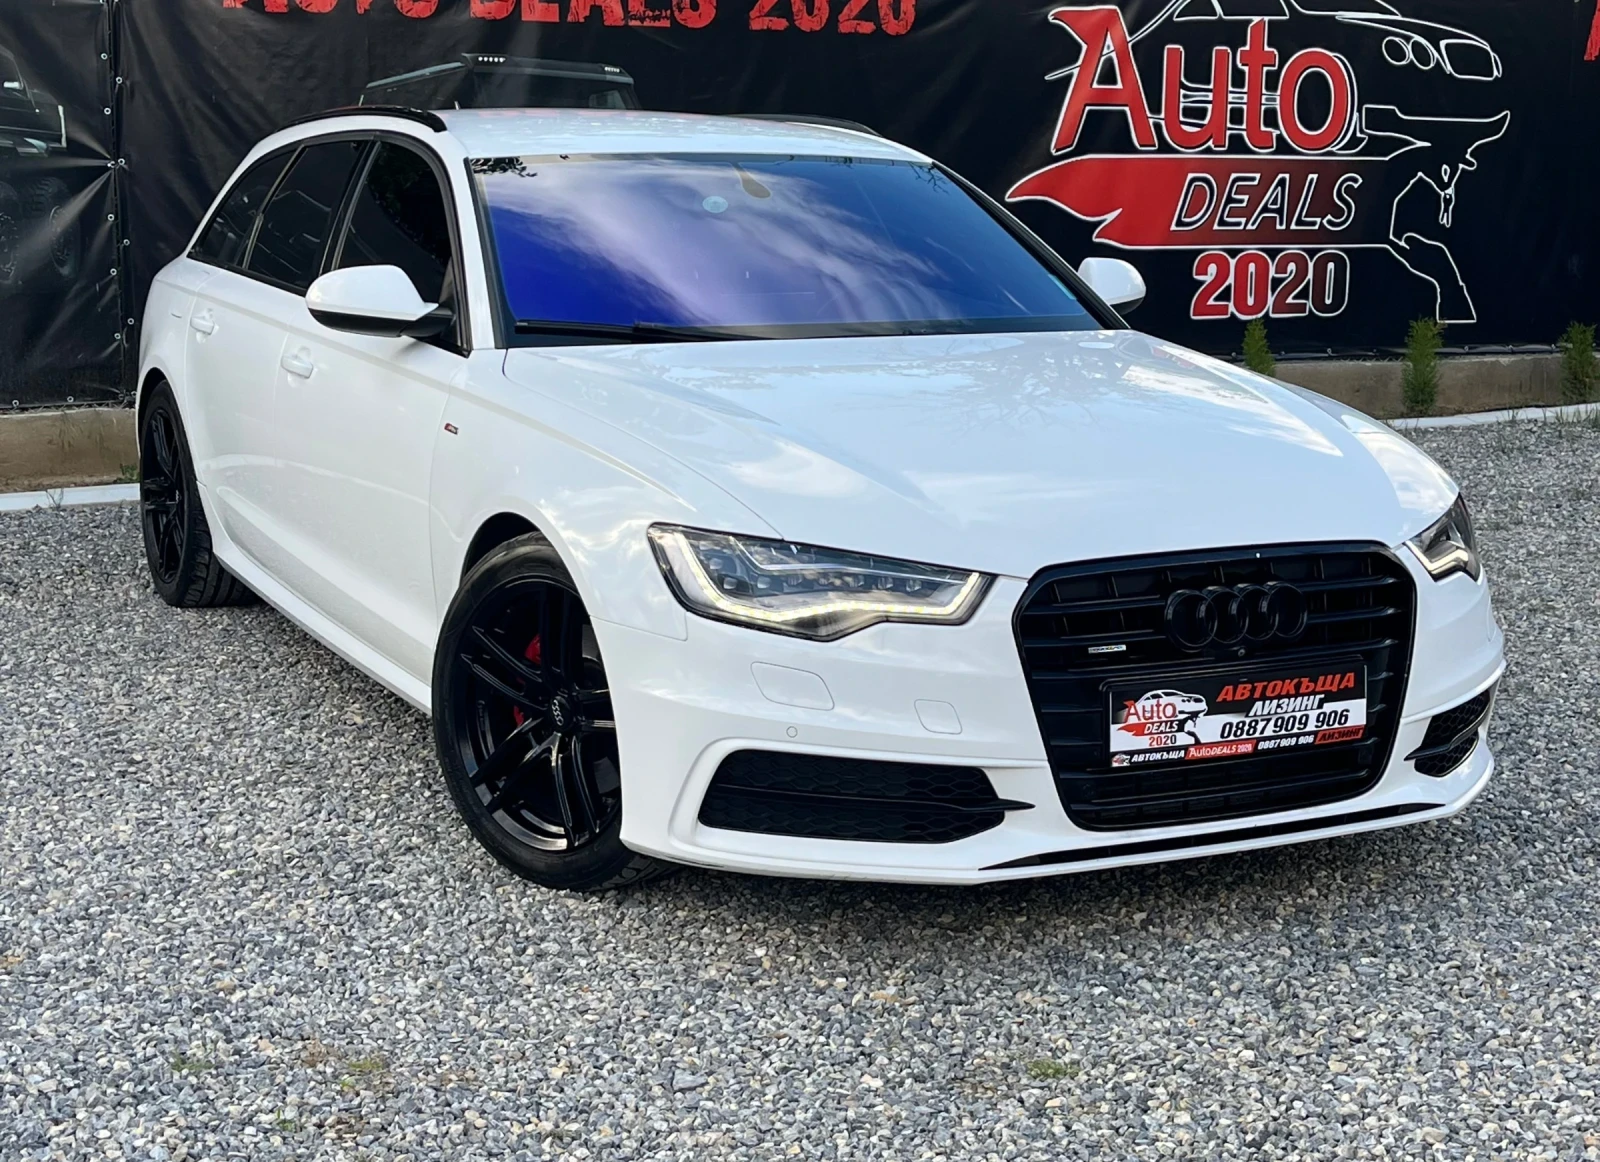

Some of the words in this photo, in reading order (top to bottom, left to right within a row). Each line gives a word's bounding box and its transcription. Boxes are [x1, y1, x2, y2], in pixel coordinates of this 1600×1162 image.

[1050, 6, 1351, 154] Auto
[1170, 173, 1363, 231] DEALS
[1190, 250, 1349, 319] 2020
[1216, 672, 1355, 703] АВТОКЪЩА
[1123, 698, 1177, 724] Auto
[1249, 694, 1325, 717] ЛИЗИНГ
[1315, 709, 1349, 728] 906
[1144, 721, 1179, 734] DEALS
[1149, 734, 1177, 747] 2020
[1131, 749, 1185, 763] АВТОКЪЩА
[1318, 727, 1364, 742] ЛИЗИНГ
